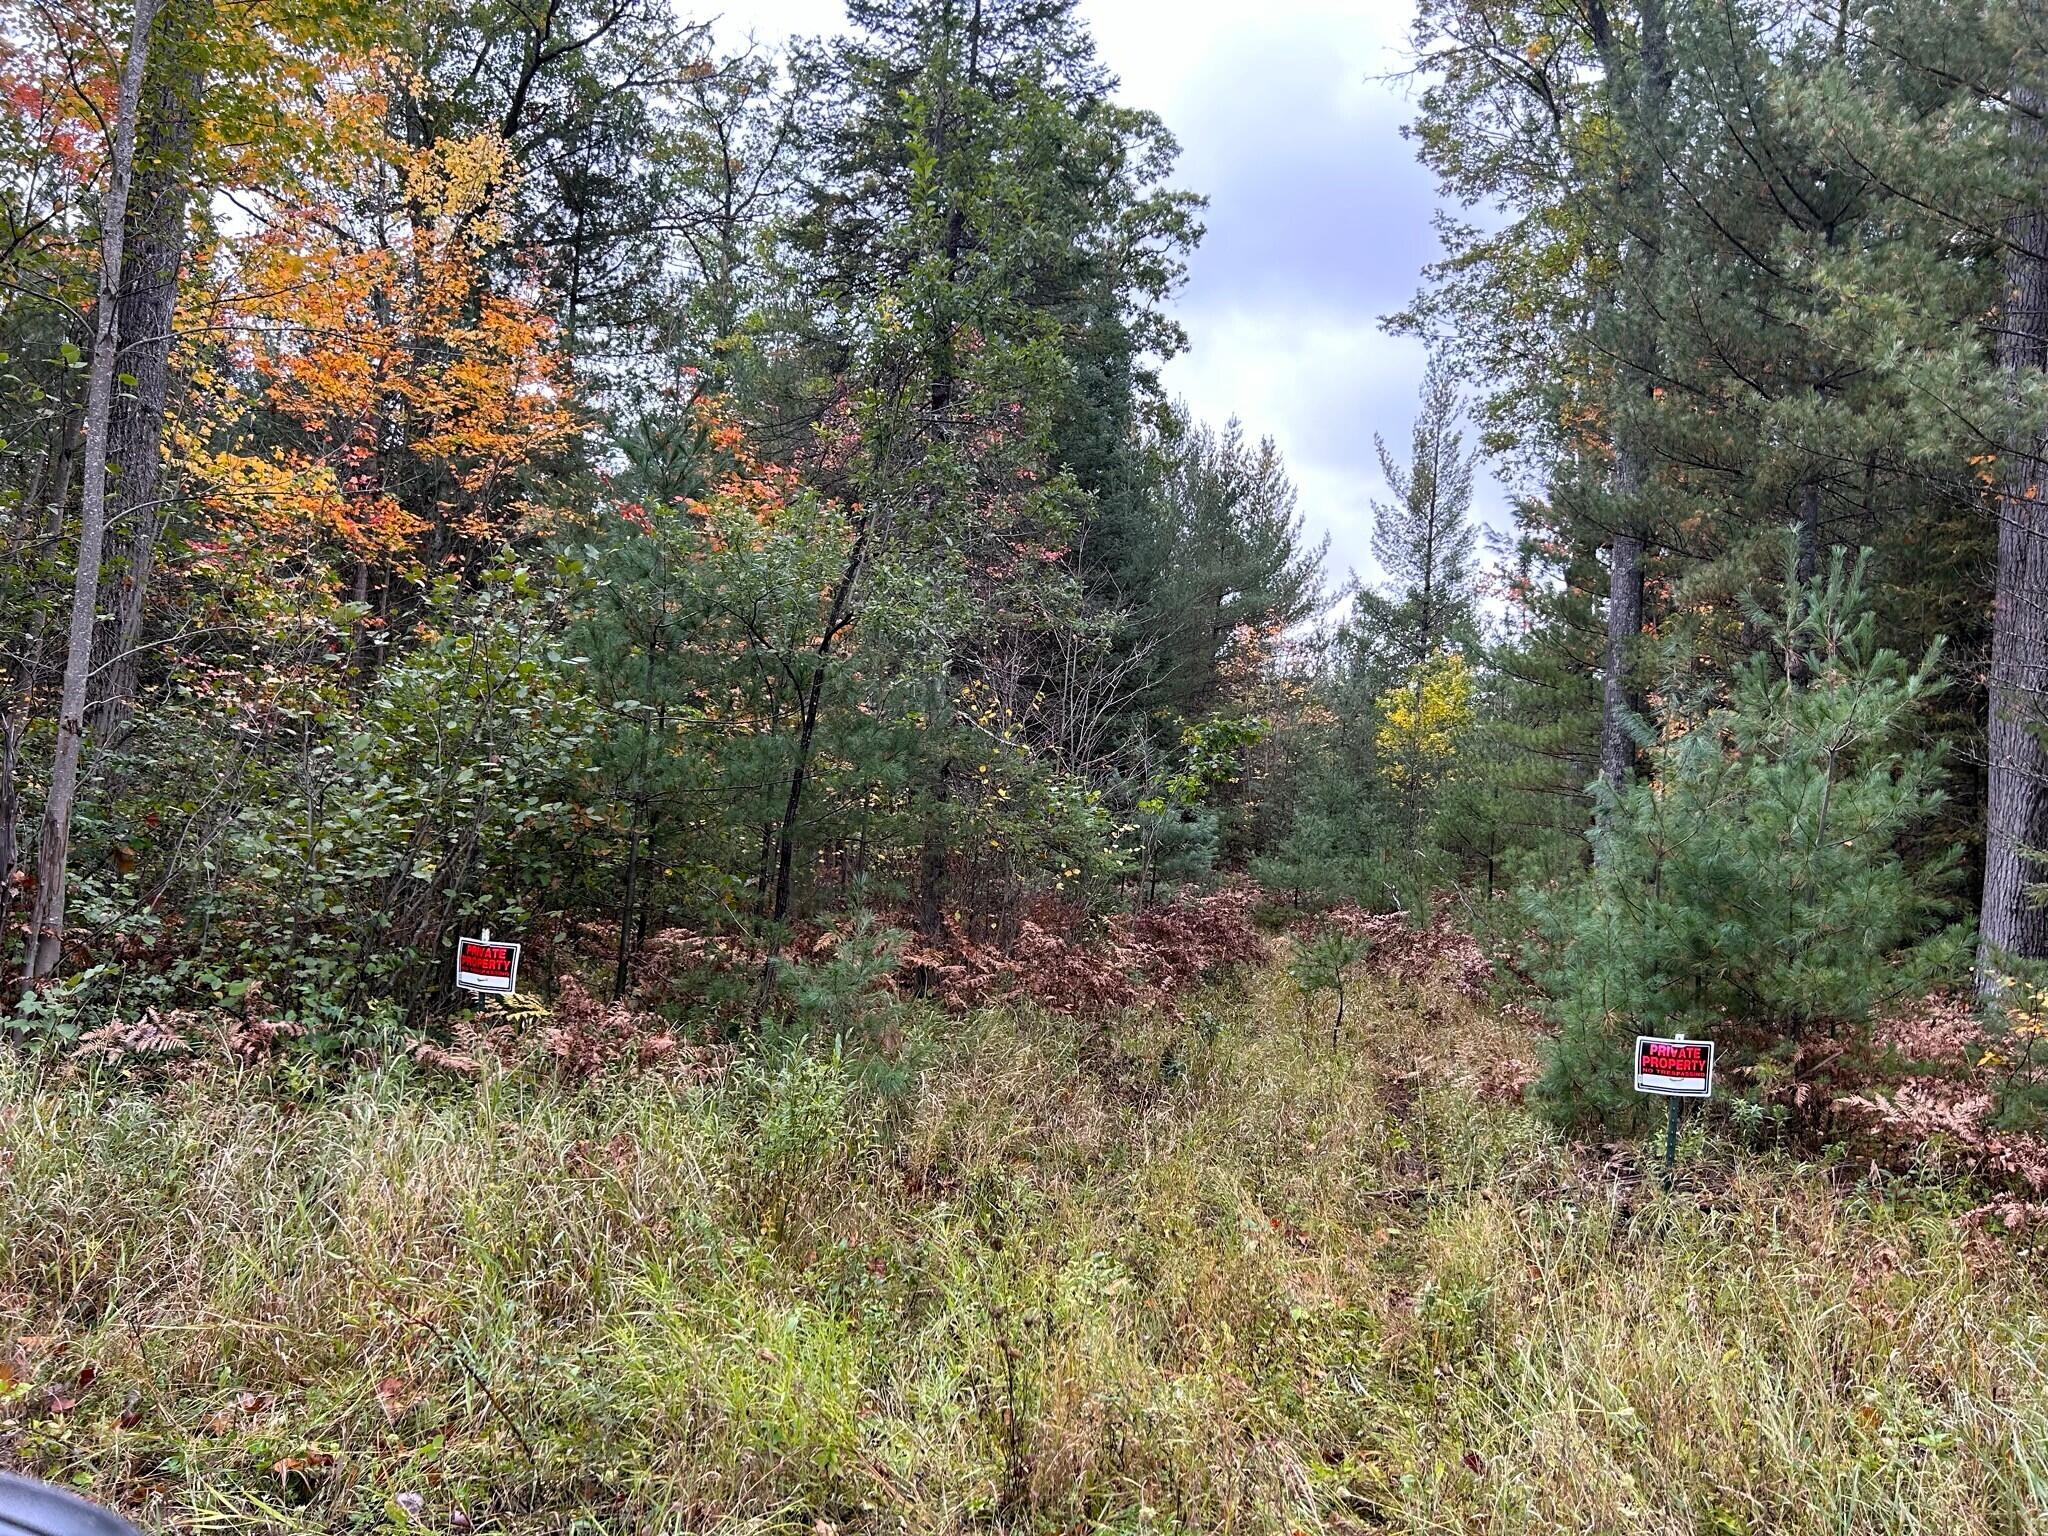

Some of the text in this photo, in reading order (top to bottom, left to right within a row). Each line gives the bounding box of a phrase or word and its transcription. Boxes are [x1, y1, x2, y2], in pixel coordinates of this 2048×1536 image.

[466, 944, 507, 959] PRIVATE
[461, 955, 511, 970] PROPERTY
[1649, 1043, 1701, 1059] PRIVATE
[1642, 1055, 1706, 1071] PROPERTY
